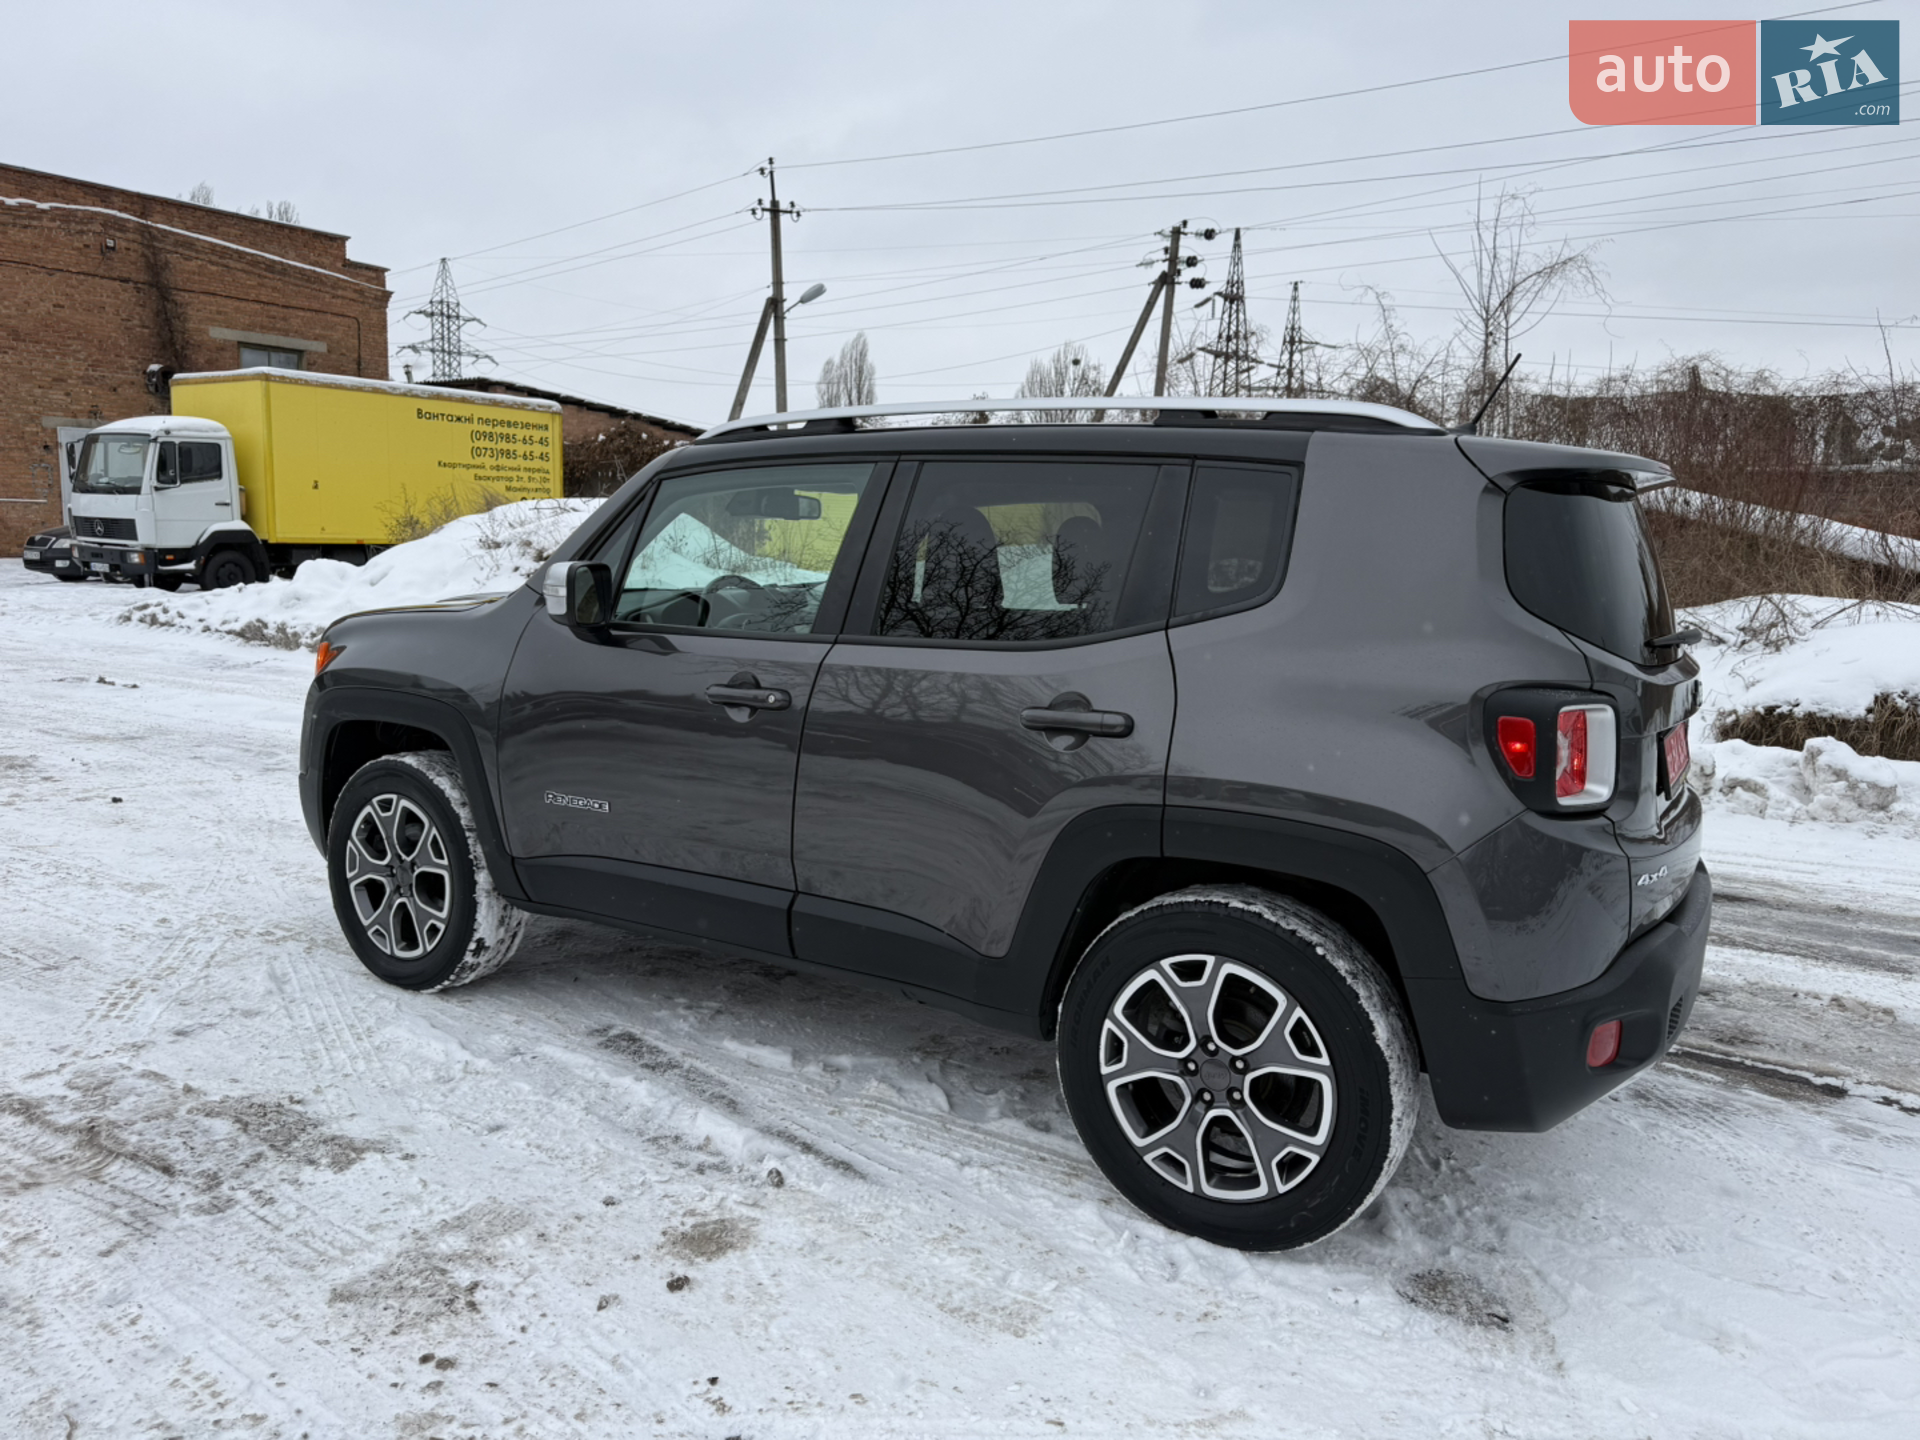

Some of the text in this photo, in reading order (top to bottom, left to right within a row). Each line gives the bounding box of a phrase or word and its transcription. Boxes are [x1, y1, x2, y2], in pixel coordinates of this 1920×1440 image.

[416, 408, 549, 432] Вантажні перевезення
[470, 430, 550, 447] (098)985-65-45
[471, 446, 550, 462] (073)985-65-45
[474, 473, 514, 484] Евакуатор
[544, 790, 609, 812] RENEGADE
[1637, 866, 1668, 886] 4x4
